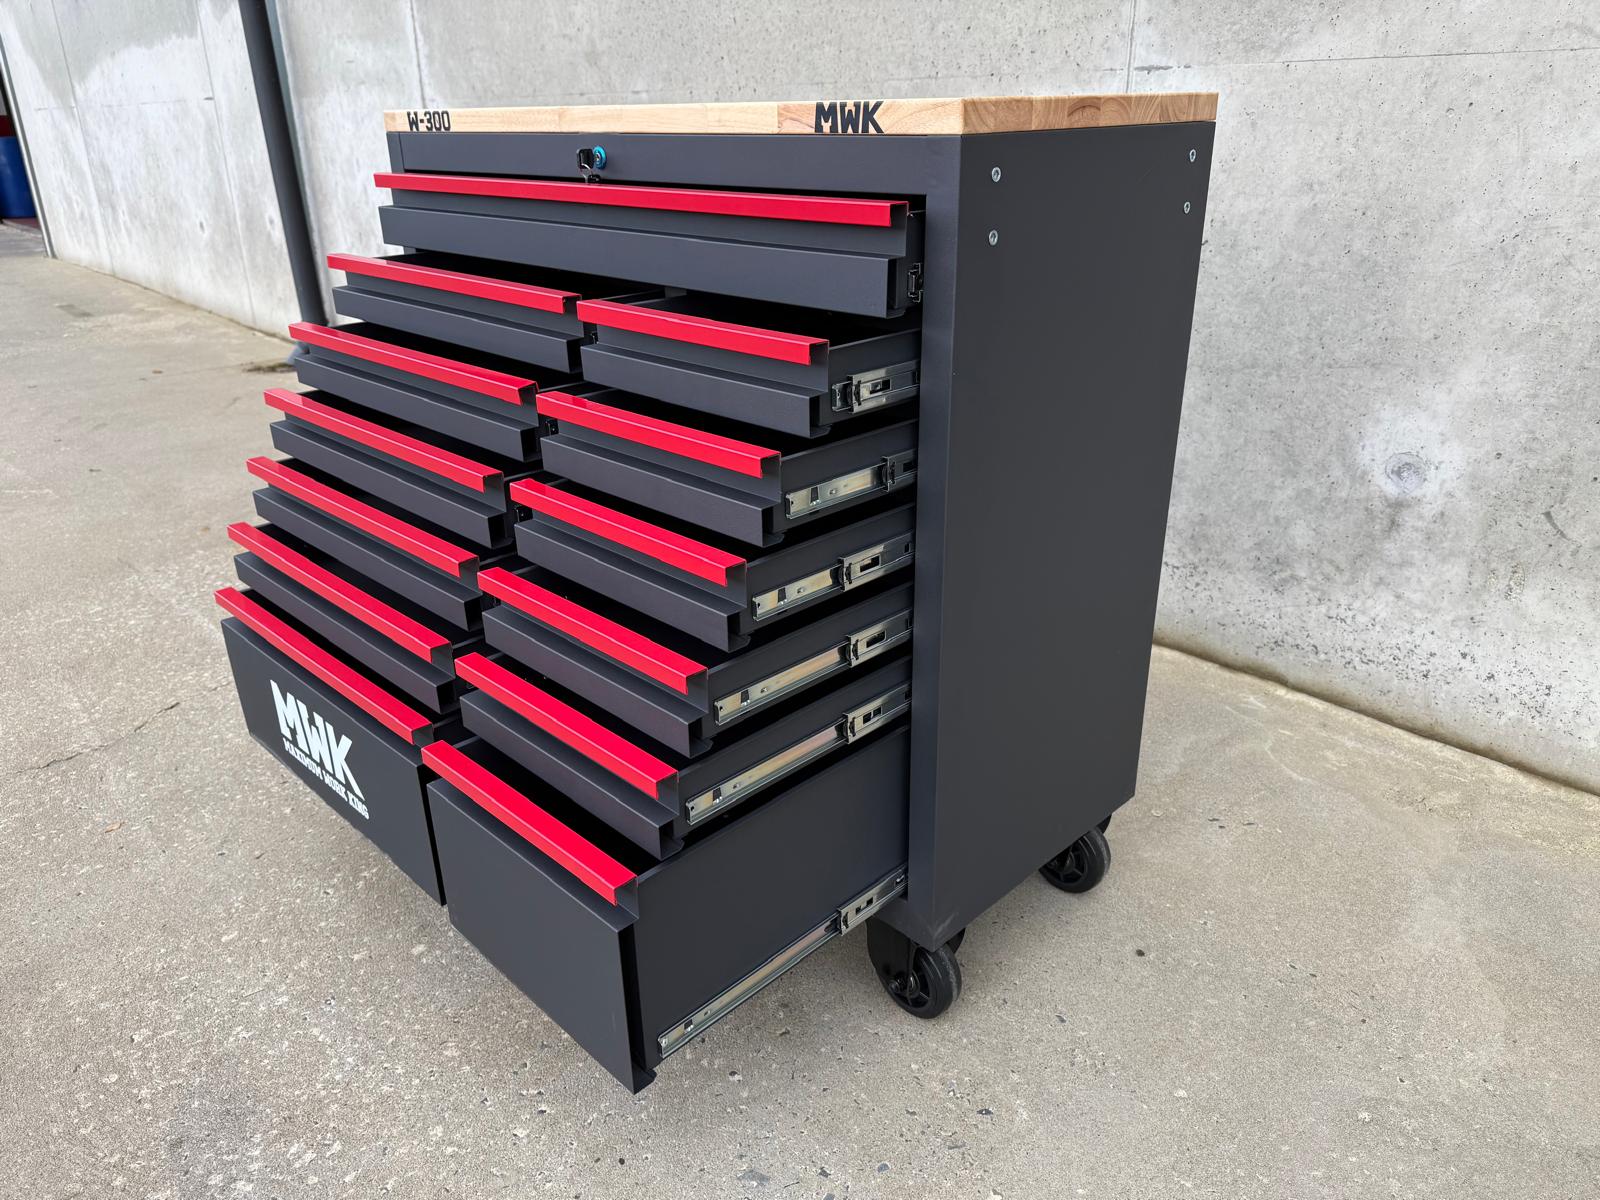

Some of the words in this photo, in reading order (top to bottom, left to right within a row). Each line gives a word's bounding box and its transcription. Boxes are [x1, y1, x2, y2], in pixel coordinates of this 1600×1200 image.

[407, 110, 451, 132] W-300
[815, 101, 884, 134] MWK
[270, 679, 365, 801] MWK
[282, 737, 323, 780] MAXIMUM
[322, 769, 348, 802] WORK
[347, 790, 370, 820] KING
